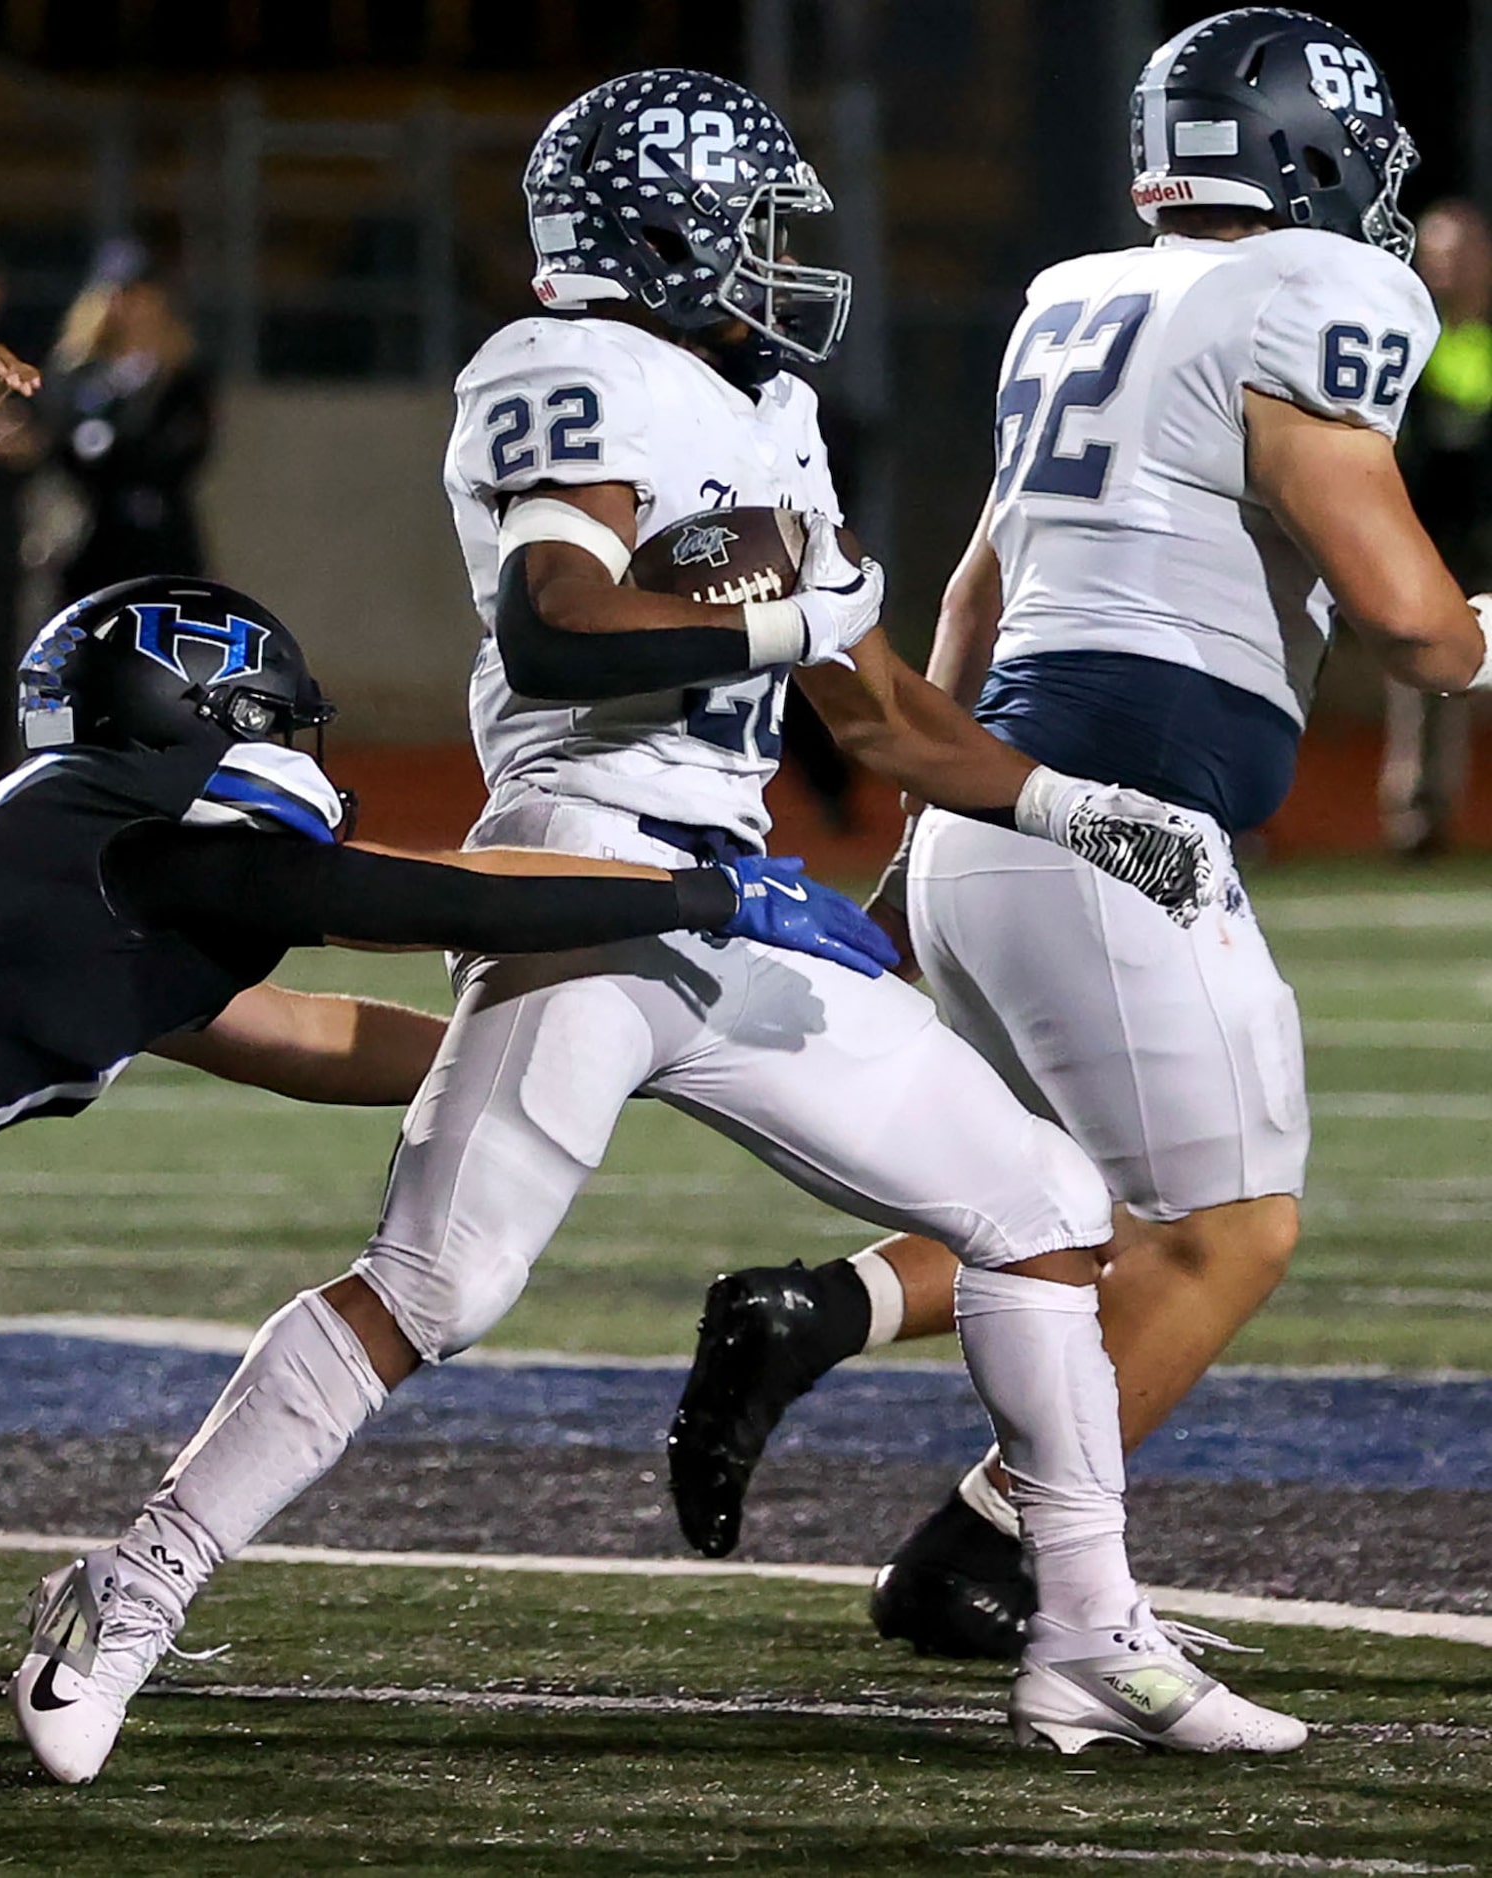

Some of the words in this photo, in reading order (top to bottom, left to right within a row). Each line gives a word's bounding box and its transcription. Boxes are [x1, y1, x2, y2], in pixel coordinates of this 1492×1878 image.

[1304, 42, 1383, 117] 62
[638, 107, 736, 183] 22
[995, 290, 1158, 500] 62
[1319, 319, 1410, 407] 62
[484, 382, 603, 482] 22
[1102, 1675, 1152, 1711] ALPHA
